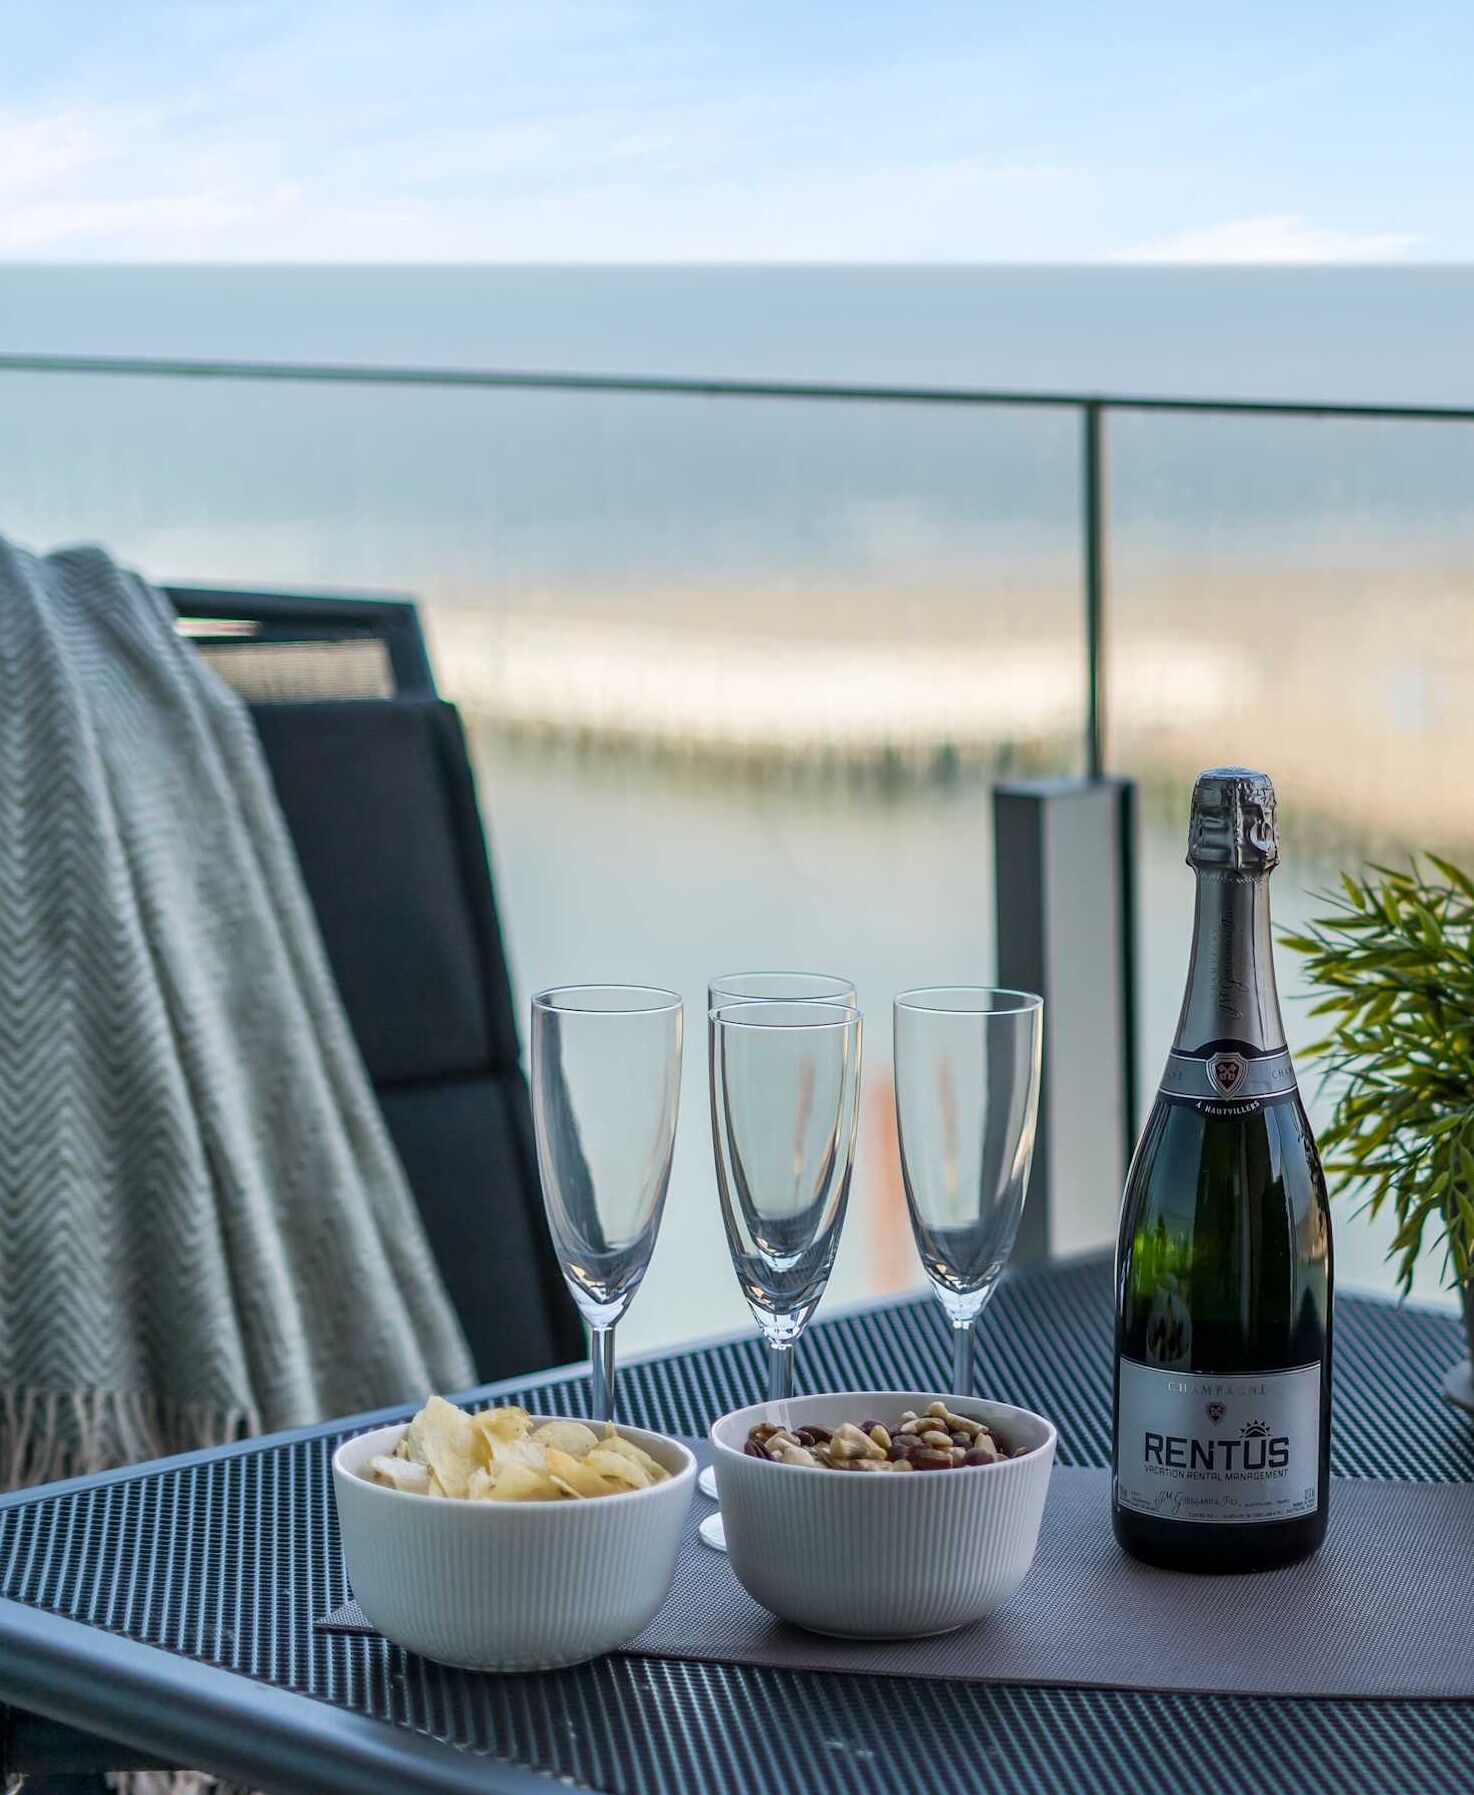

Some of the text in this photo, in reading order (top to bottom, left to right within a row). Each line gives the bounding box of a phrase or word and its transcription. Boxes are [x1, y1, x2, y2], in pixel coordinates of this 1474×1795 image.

[1205, 1100, 1260, 1115] HAUTVILLERS
[1168, 1381, 1267, 1396] CHAMPAGNE
[1145, 1432, 1290, 1471] RENTUS
[1145, 1465, 1289, 1482] VACATION RENTAL MANAGEMENT
